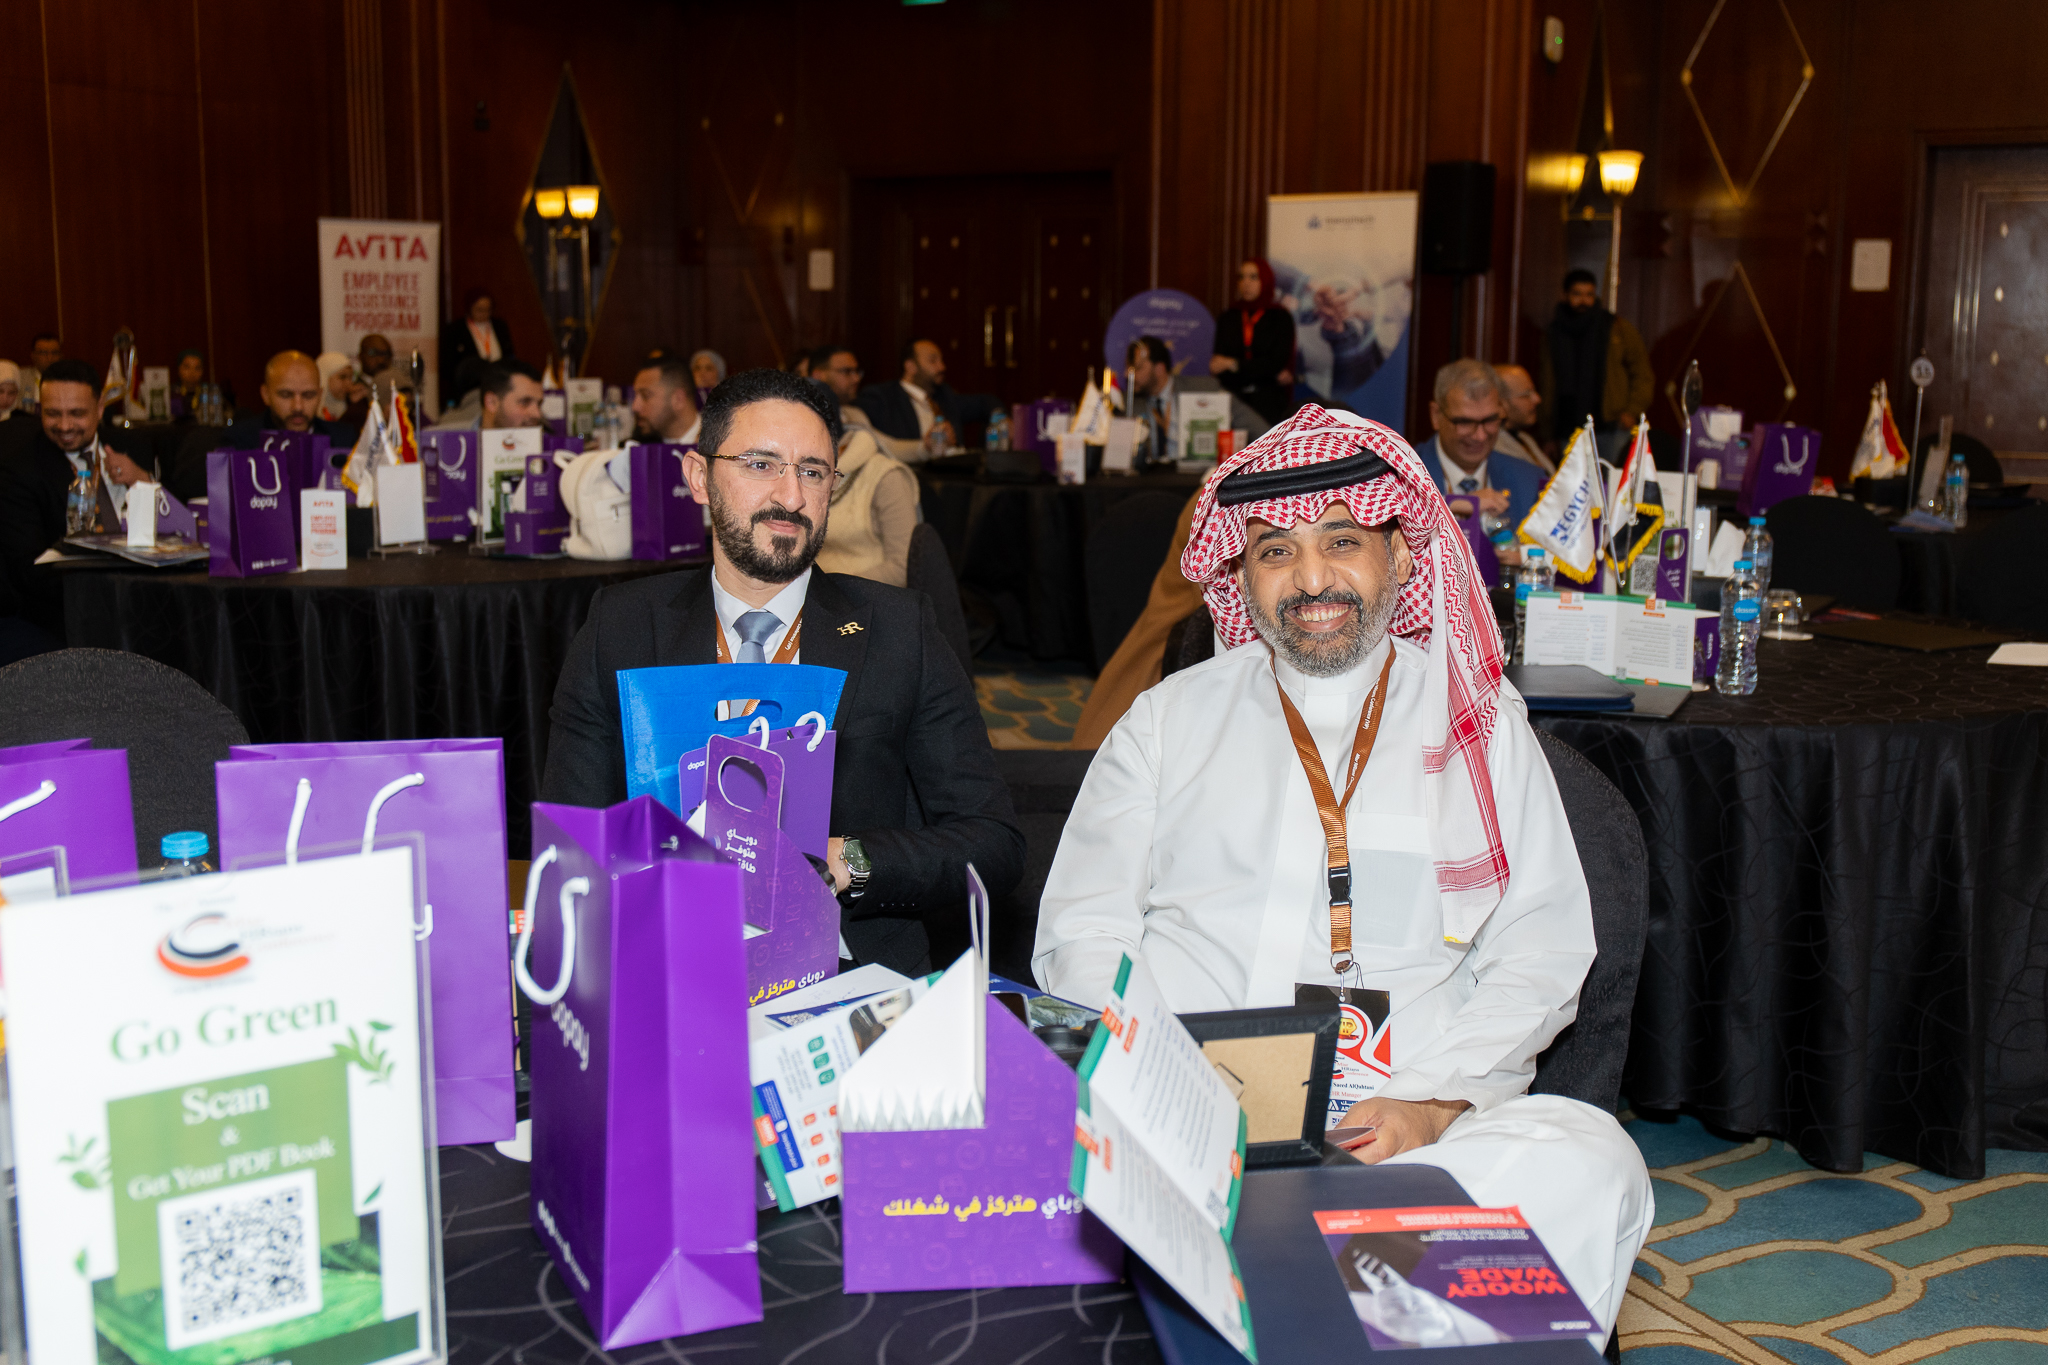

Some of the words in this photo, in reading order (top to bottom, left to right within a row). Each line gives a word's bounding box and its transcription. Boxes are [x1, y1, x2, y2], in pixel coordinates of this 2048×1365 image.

[344, 311, 421, 332] PROGRAM
[837, 621, 864, 636] HR
[687, 760, 706, 771] dopa
[110, 1019, 181, 1063] Go
[197, 997, 339, 1047] Green
[181, 1083, 270, 1126] Scan
[219, 1125, 241, 1147] &
[127, 1173, 172, 1200] Get
[171, 1161, 225, 1190] Your
[227, 1147, 277, 1179] PDF
[278, 1136, 336, 1168] Book
[882, 1194, 950, 1217] شغلك
[953, 1195, 982, 1222] في
[1457, 1266, 1560, 1284] WADE
[1446, 1280, 1569, 1299] WOODY
